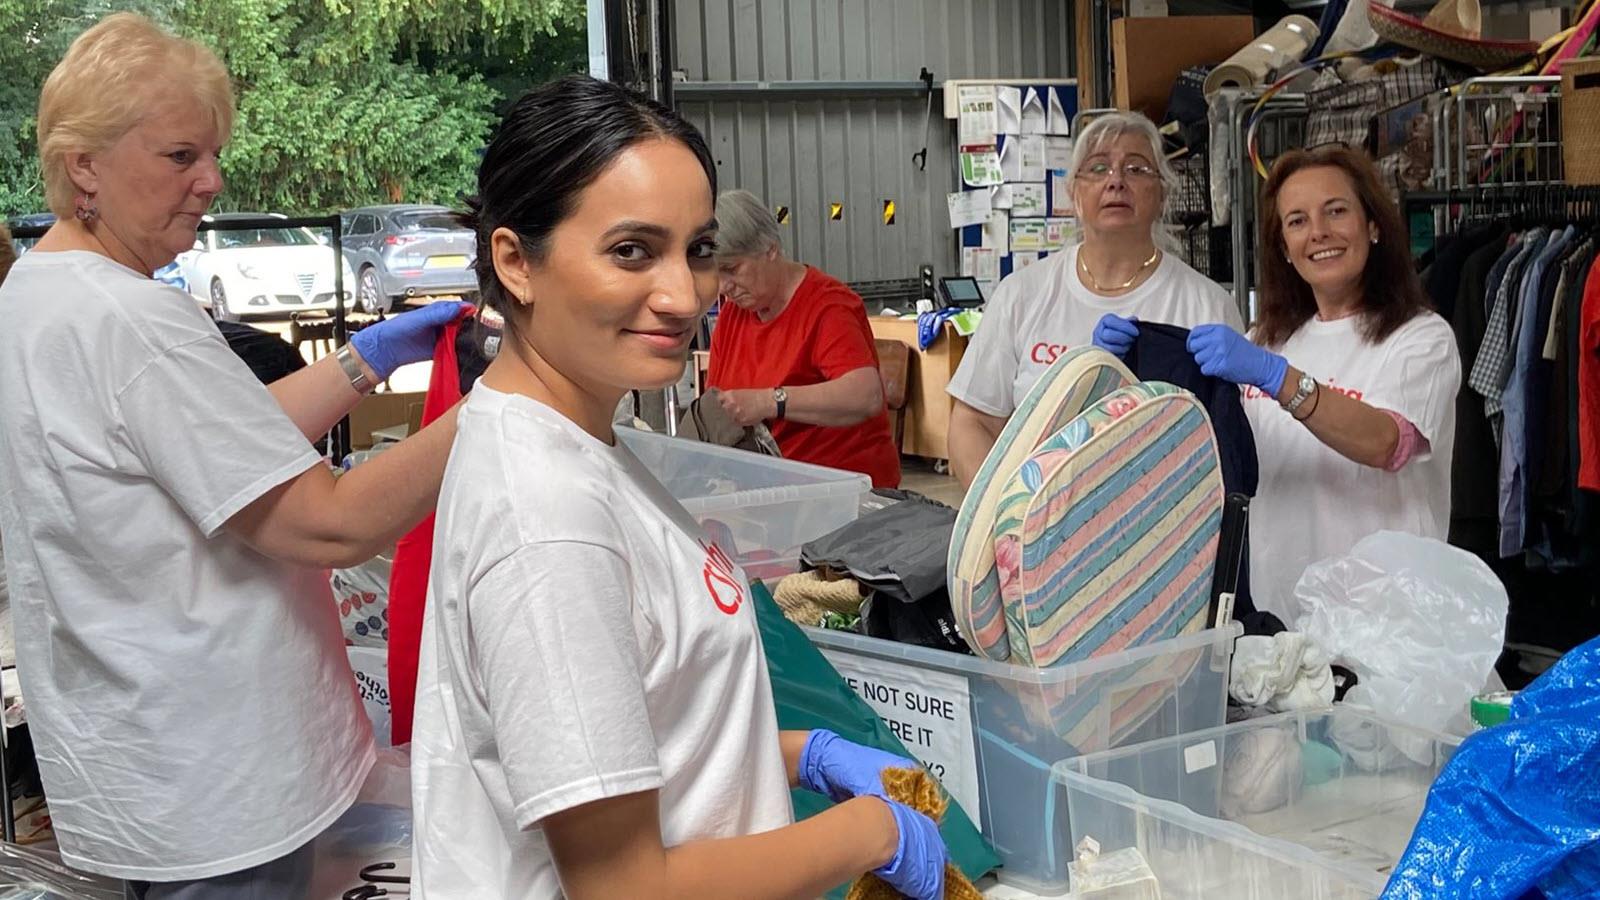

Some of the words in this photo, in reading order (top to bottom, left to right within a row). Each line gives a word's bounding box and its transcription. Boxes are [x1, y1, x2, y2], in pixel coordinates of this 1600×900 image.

[864, 681, 900, 706] NOT
[905, 692, 955, 721] SURE
[918, 727, 933, 747] IT
